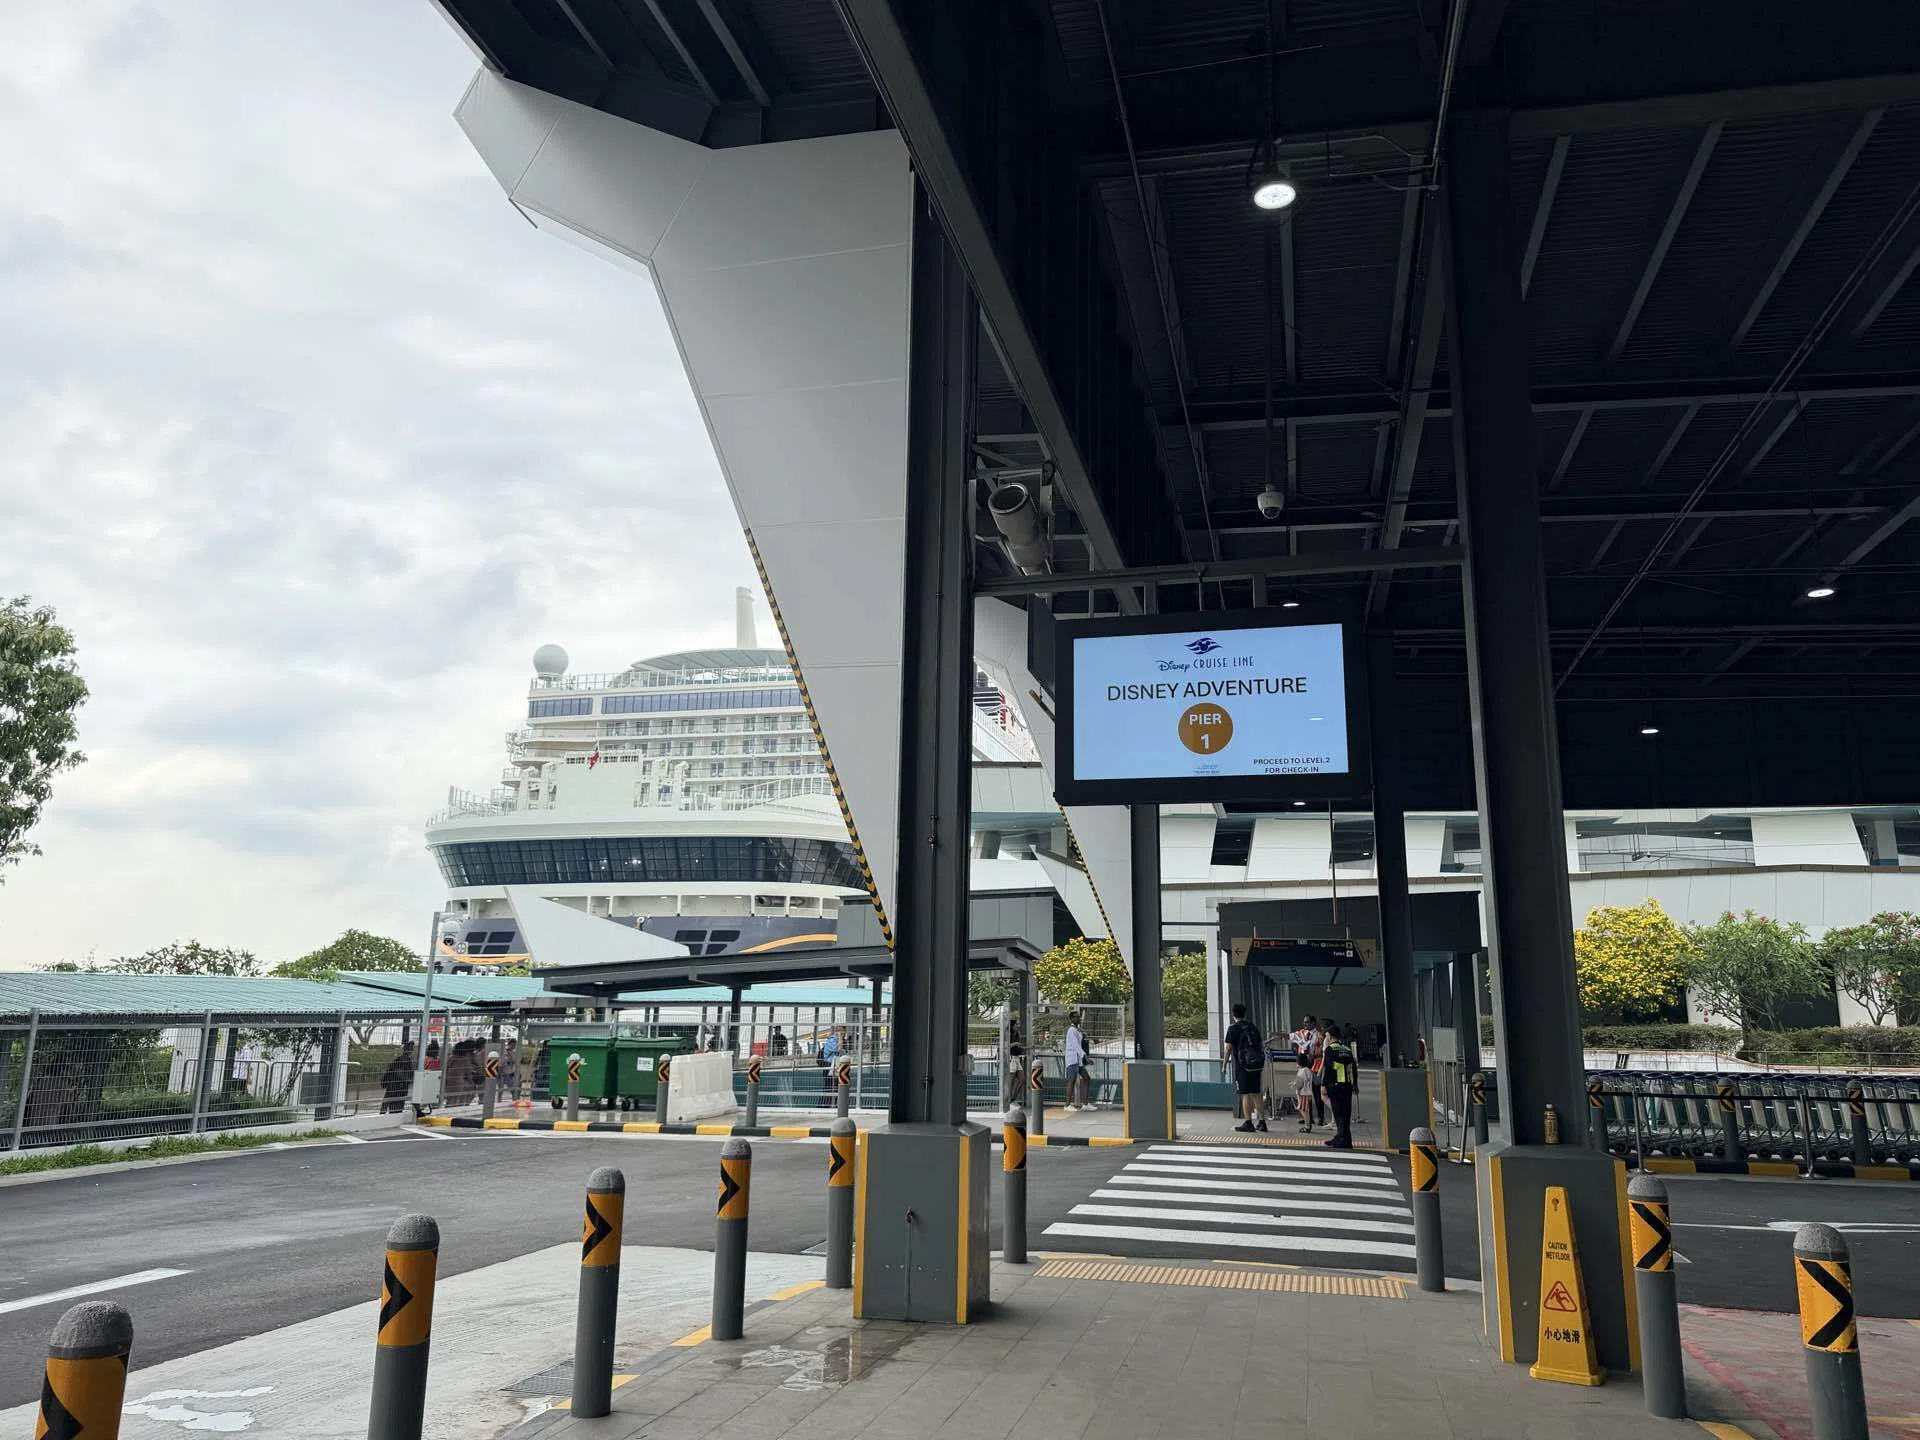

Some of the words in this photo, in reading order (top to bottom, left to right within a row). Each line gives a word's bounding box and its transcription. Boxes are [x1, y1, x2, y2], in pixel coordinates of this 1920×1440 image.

[1156, 660, 1190, 672] Disney
[1193, 658, 1227, 669] CRUISE
[1233, 656, 1254, 667] LINE
[1107, 682, 1179, 701] DISNEY
[1183, 677, 1307, 698] ADVENTURE
[1189, 713, 1222, 726] PIER
[1200, 733, 1210, 750] 1
[1281, 766, 1319, 774] CHECK-IN
[1548, 1242, 1567, 1250] CAUTION
[1546, 1252, 1555, 1260] WET
[1555, 1253, 1570, 1262] FLOOR
[1544, 1327, 1580, 1344] 小心地滑
